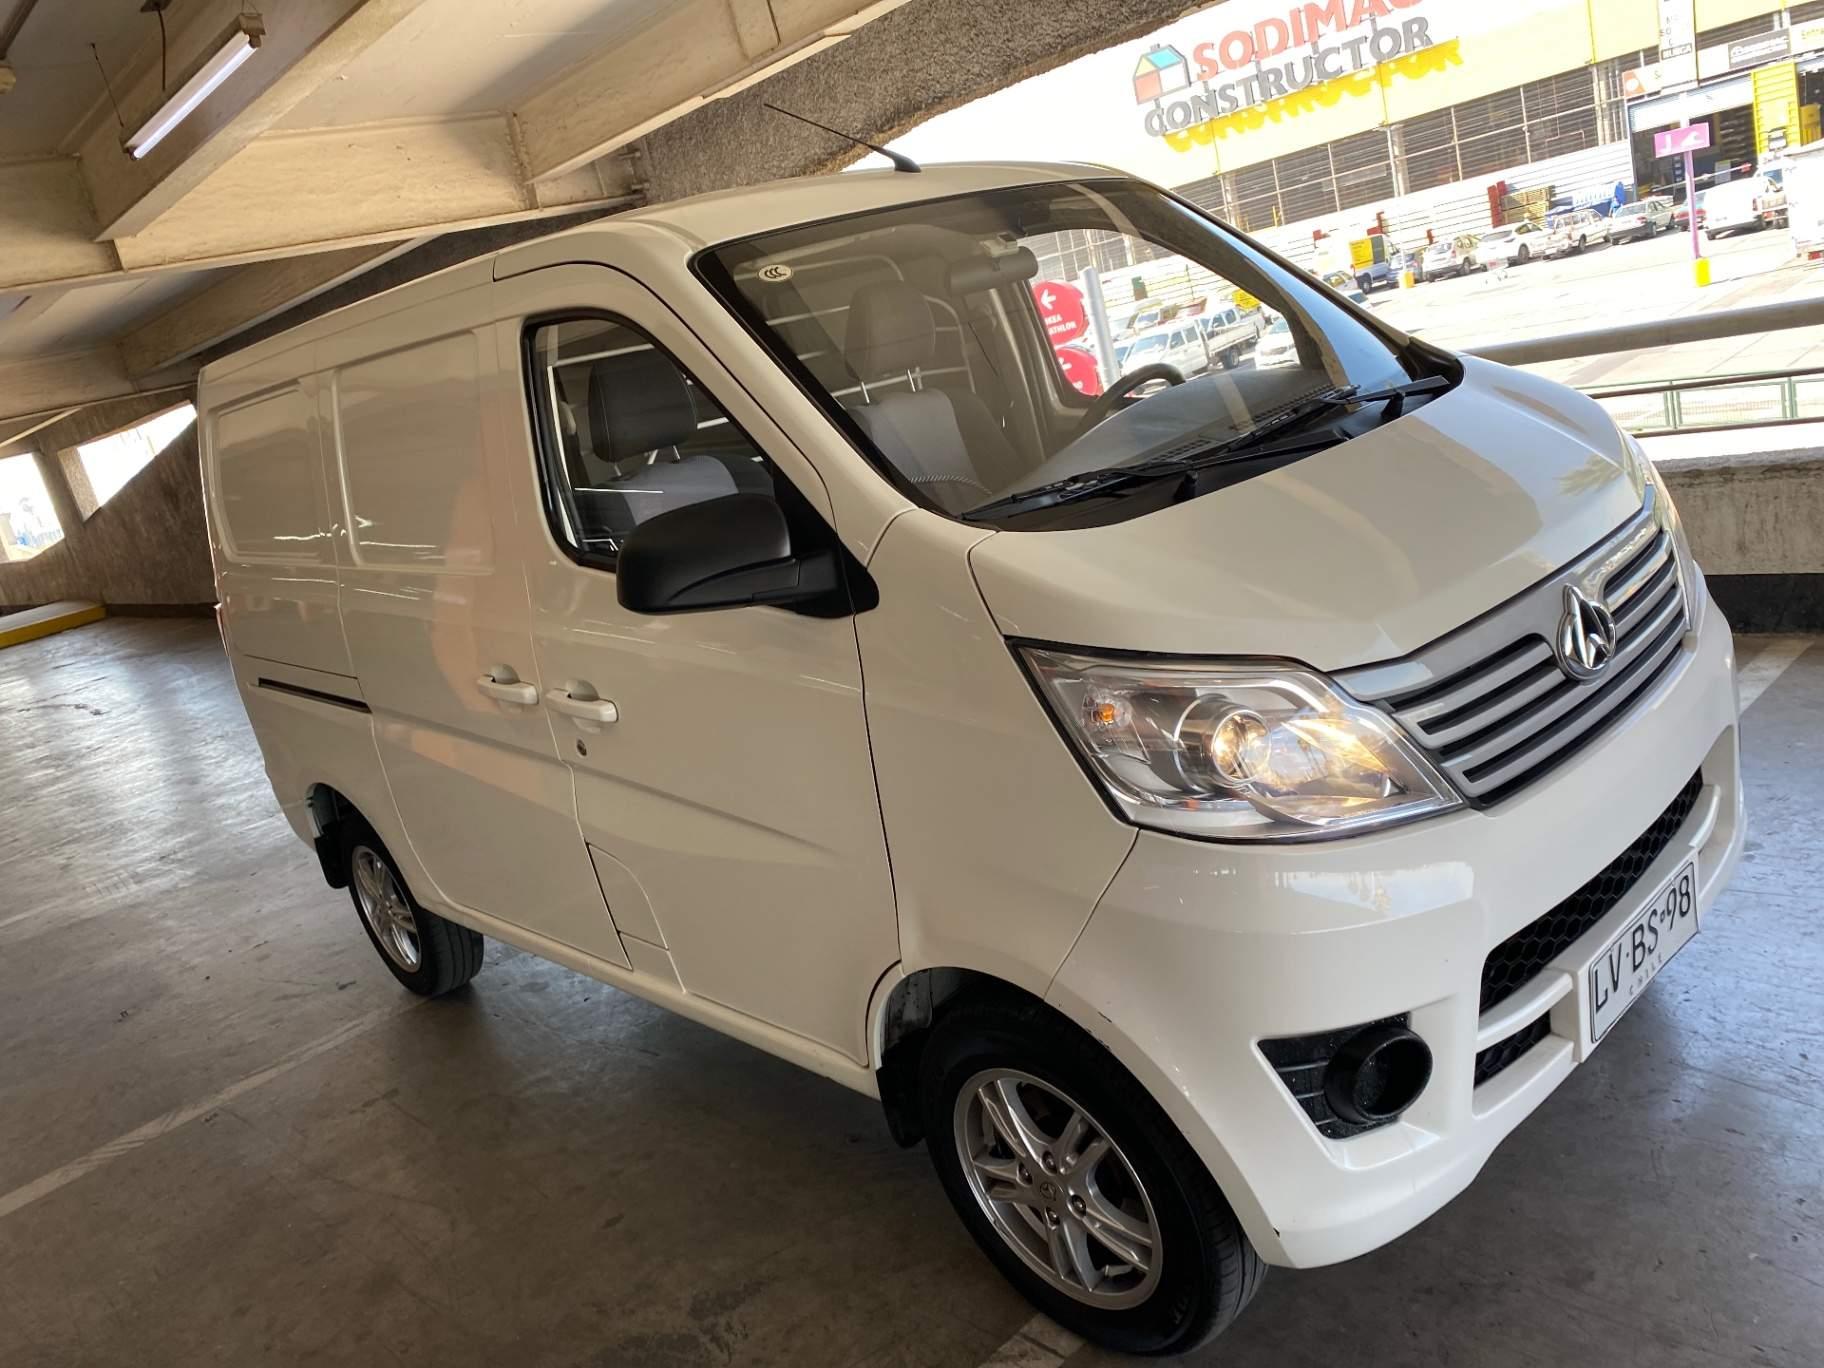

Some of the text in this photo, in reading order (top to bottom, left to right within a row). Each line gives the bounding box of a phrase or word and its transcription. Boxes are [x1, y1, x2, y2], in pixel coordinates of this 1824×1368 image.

[1144, 16, 1434, 137] CONSTRUCTOR
[1192, 0, 1422, 82] SODIMA
[1048, 321, 1077, 335] ATHLON
